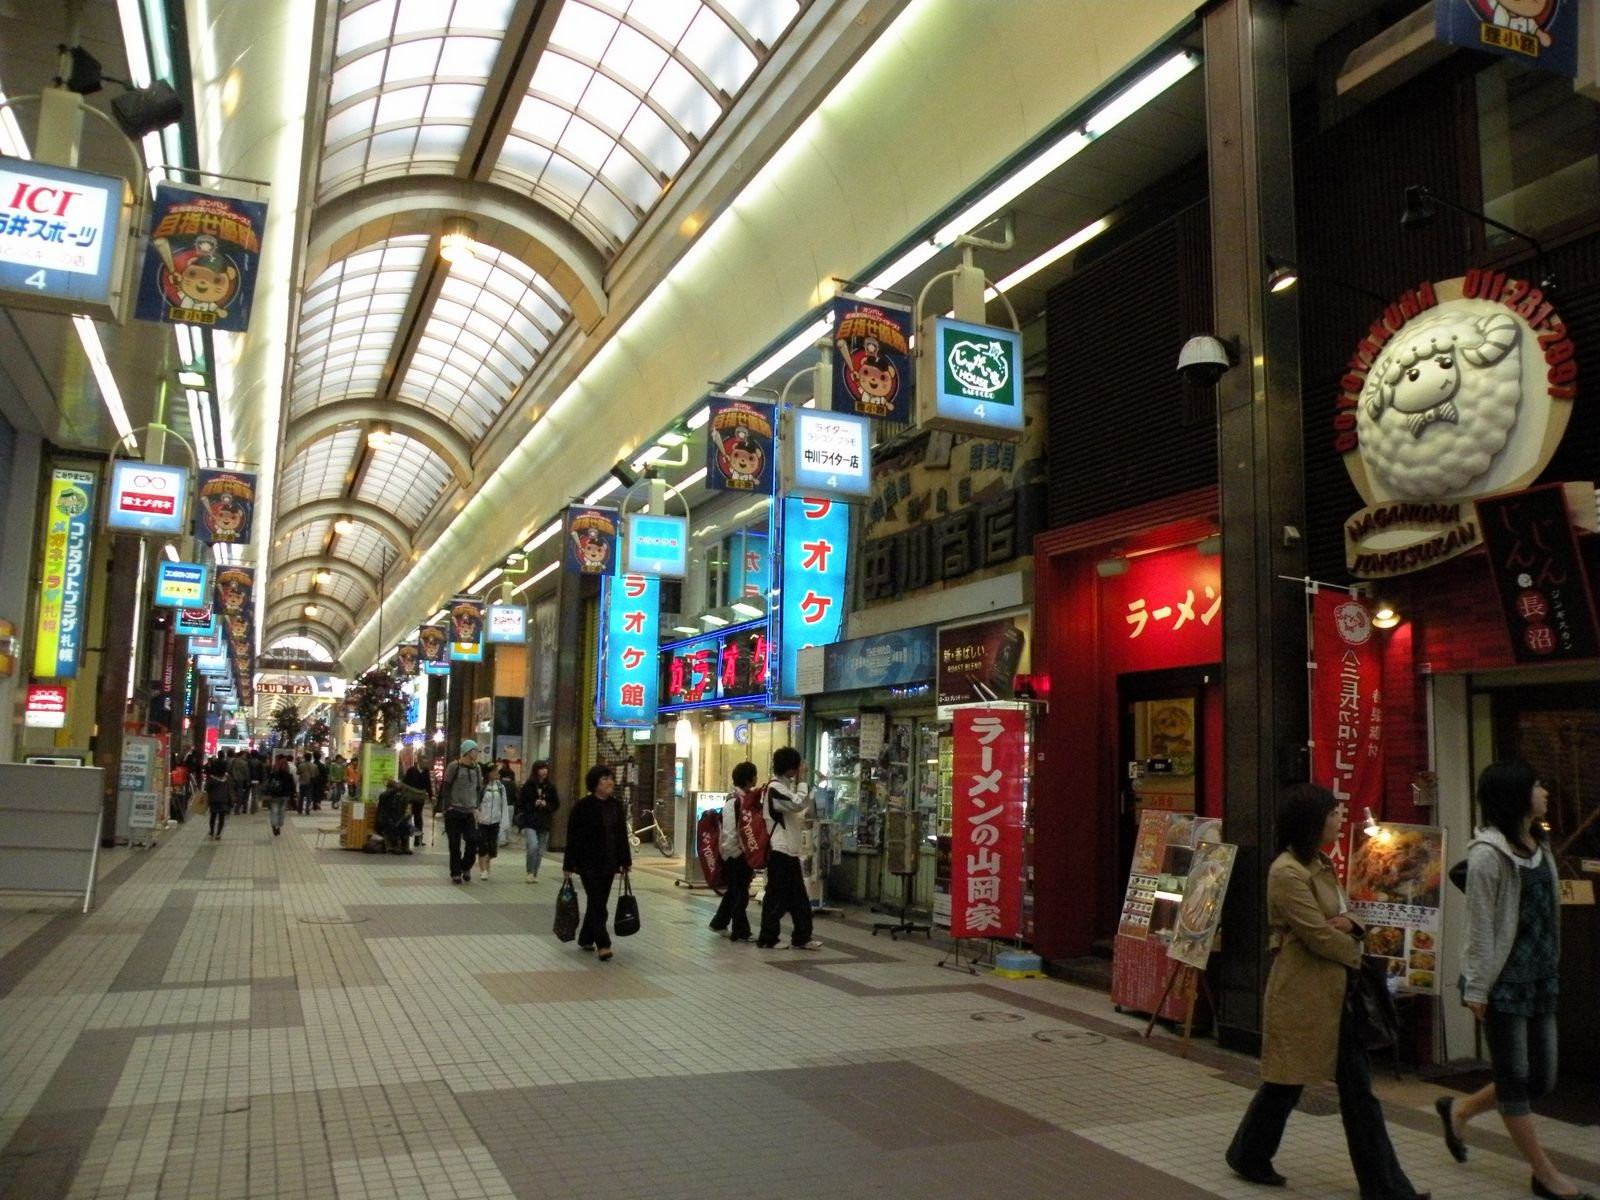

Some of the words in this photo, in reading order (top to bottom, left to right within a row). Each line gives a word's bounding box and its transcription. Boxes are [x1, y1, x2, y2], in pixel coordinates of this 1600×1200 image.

[8, 183, 83, 217] ICI
[24, 269, 46, 289] 4
[959, 370, 989, 388] HOUSE
[974, 403, 986, 418] 4
[815, 423, 848, 434] ライター
[804, 449, 860, 469] 中川ライター店
[826, 475, 838, 488] 4
[1347, 503, 1461, 542] NAGANUMA
[1126, 586, 1222, 639] ラーメン
[1518, 594, 1554, 651] 長沼
[965, 717, 1005, 931] ラーメンの山岡家
[744, 822, 759, 852] YONEX
